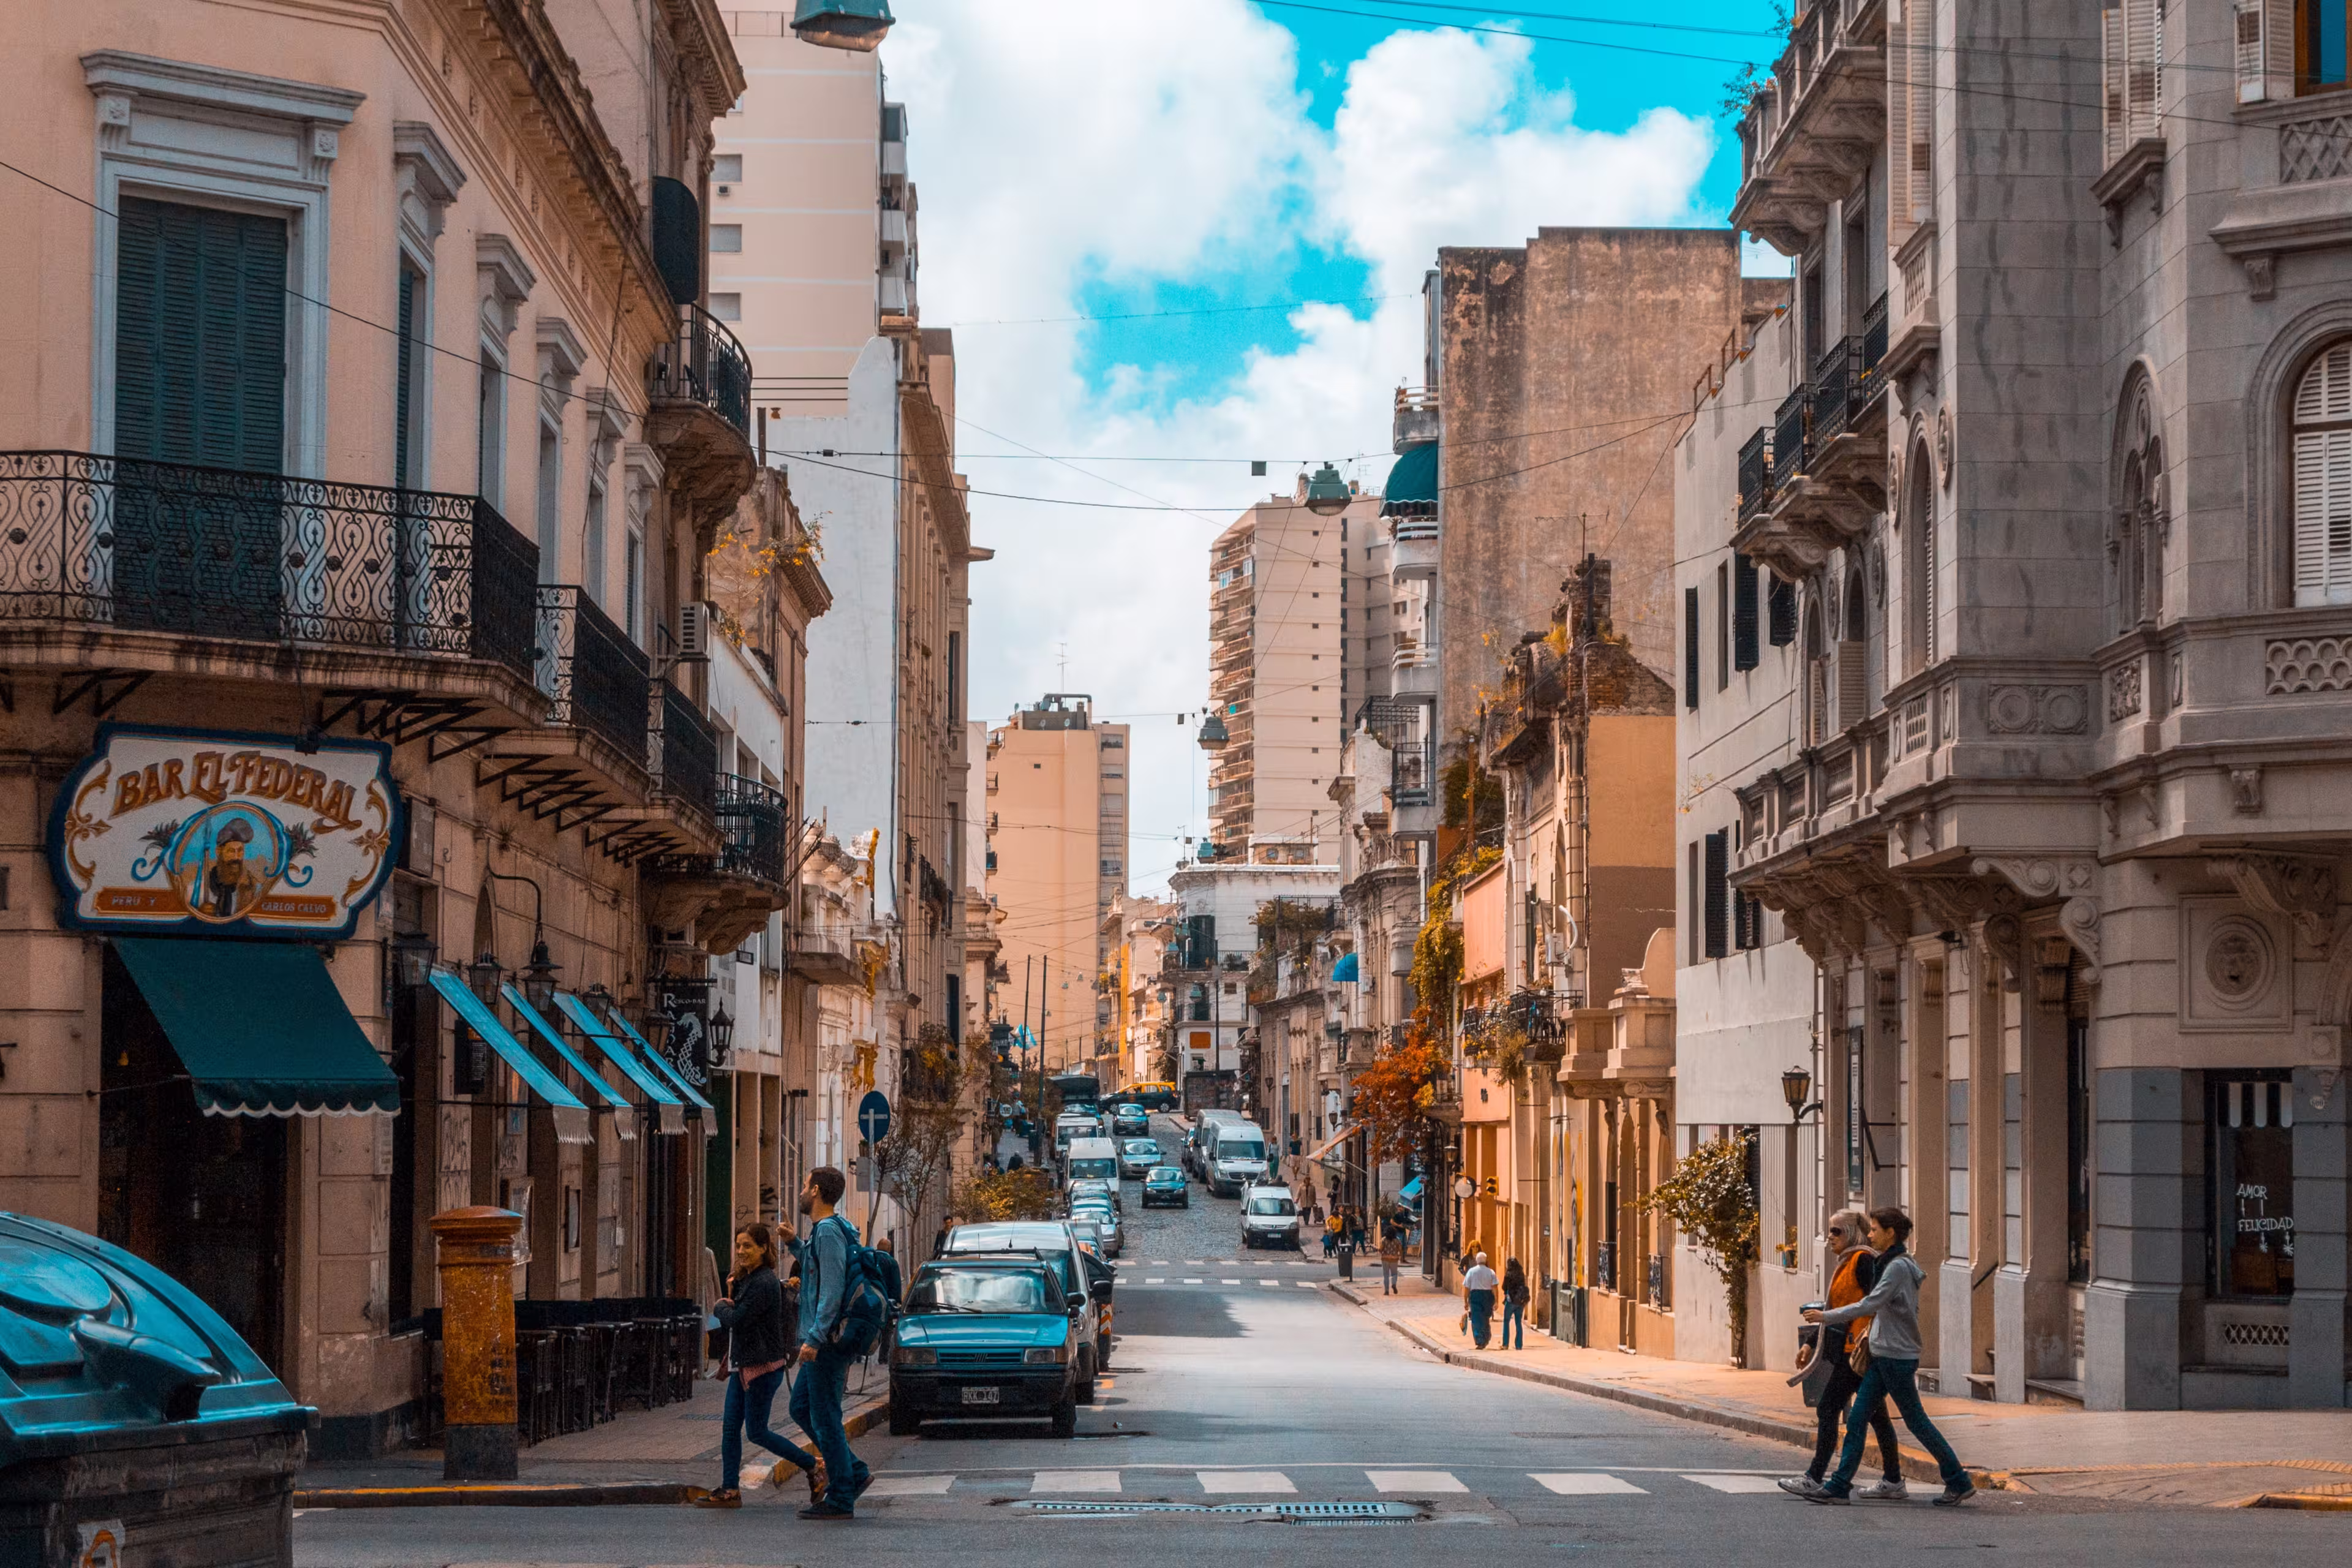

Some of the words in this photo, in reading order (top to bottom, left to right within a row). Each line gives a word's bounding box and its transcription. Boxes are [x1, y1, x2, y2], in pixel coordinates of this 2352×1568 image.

[109, 758, 186, 820] BAR
[189, 751, 230, 804] EL
[225, 750, 362, 834] FEDERAL
[148, 897, 157, 907] Y
[262, 902, 295, 911] CARLOS
[298, 903, 326, 913] CALVO
[2236, 1183, 2267, 1199] AMOR
[2238, 1216, 2294, 1232] FELICIDAD
